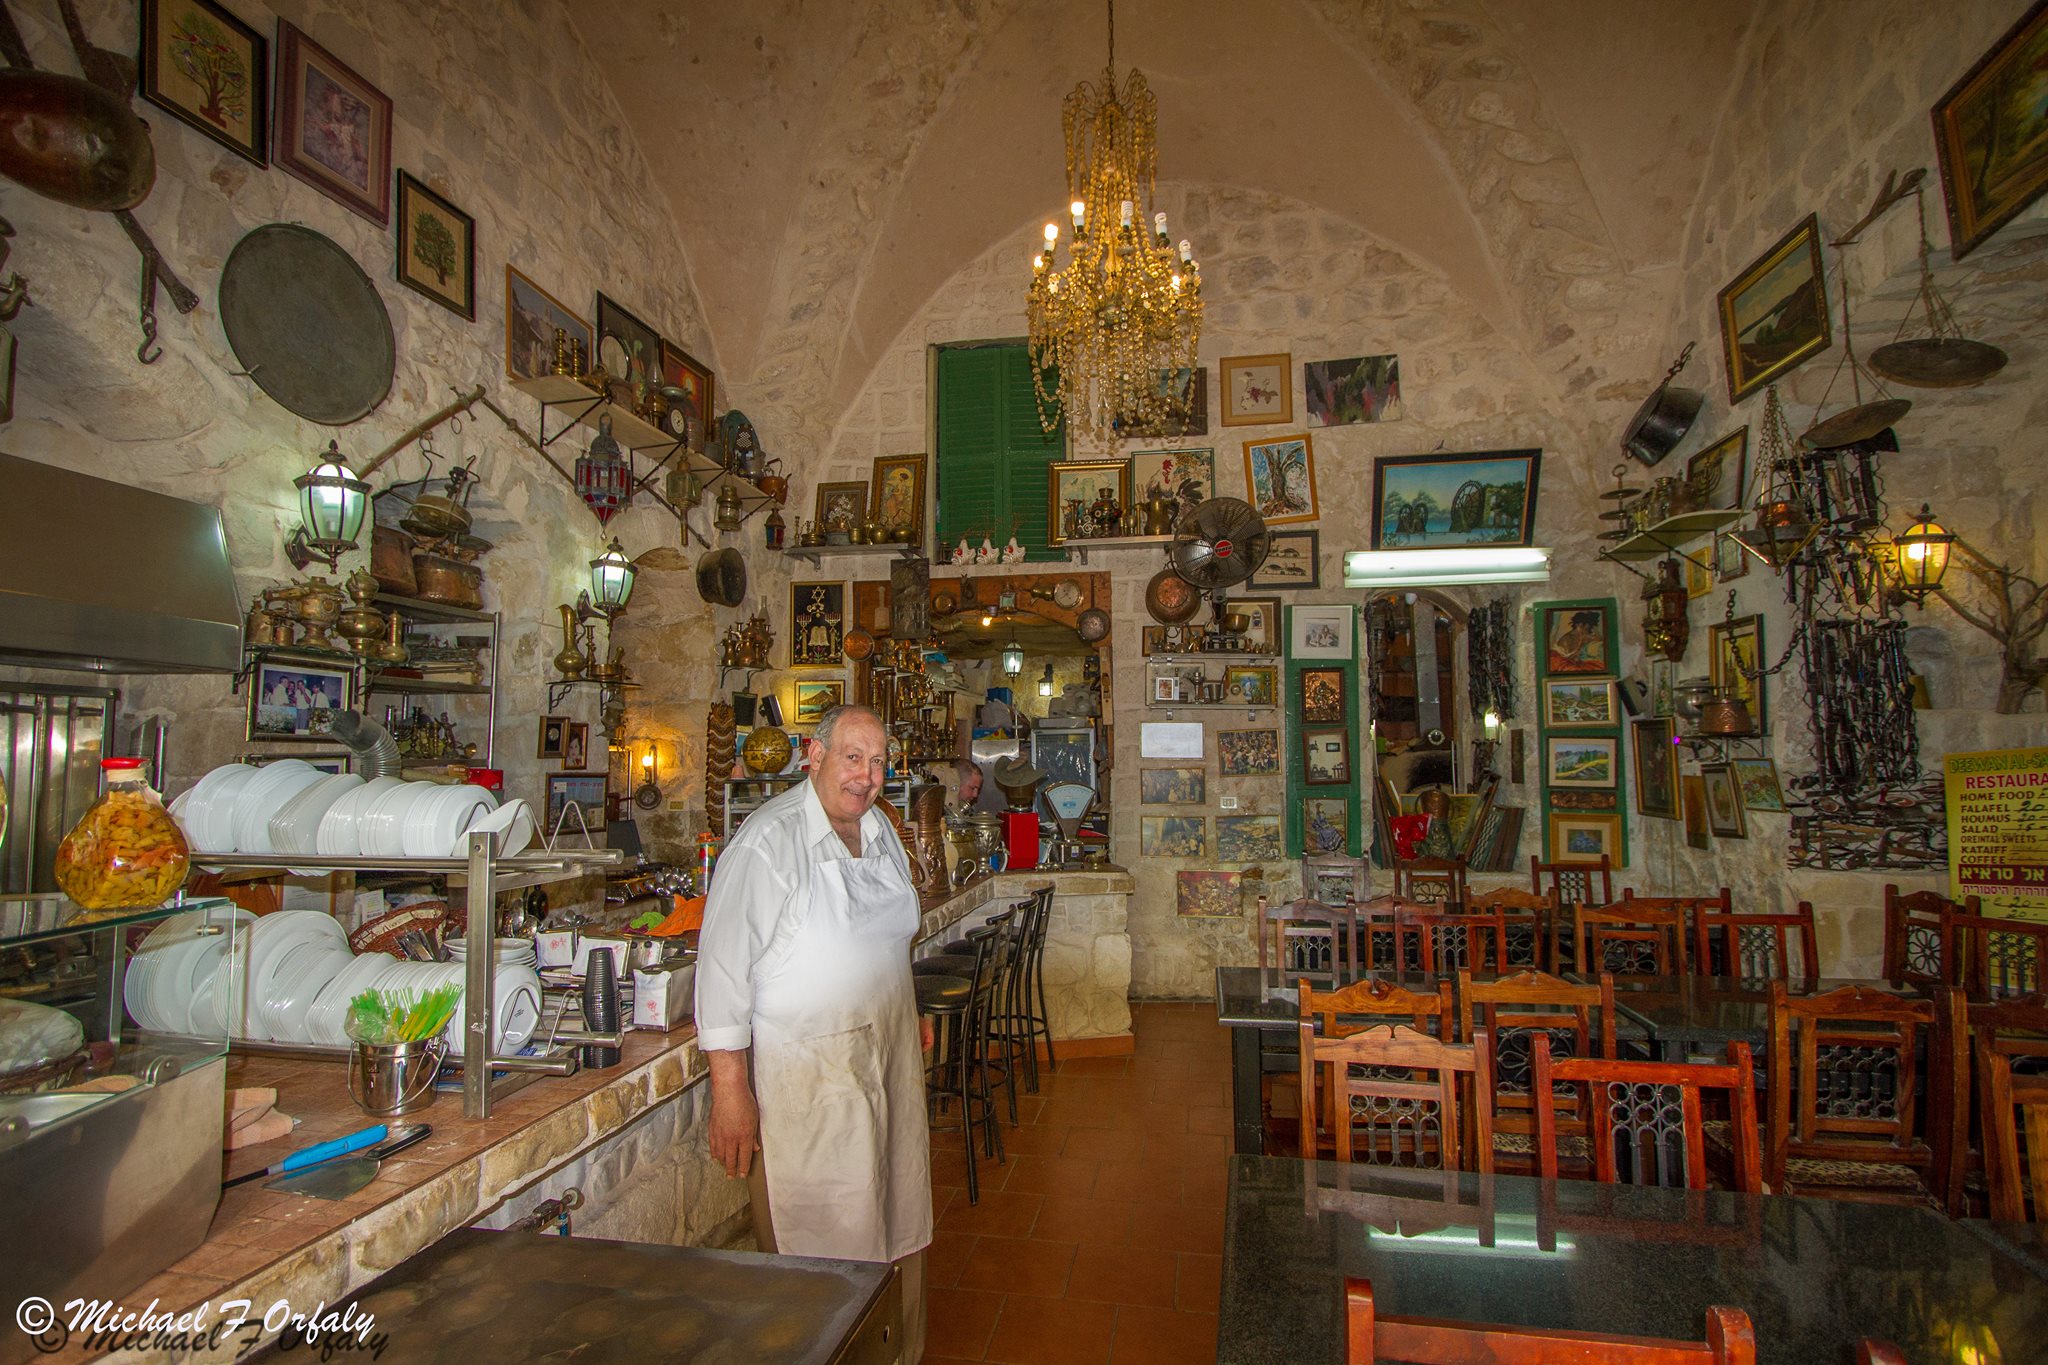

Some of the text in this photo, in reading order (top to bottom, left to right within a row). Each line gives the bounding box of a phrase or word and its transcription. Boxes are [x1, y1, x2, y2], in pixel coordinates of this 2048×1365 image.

[1960, 792, 1994, 802] HOME
[1998, 791, 2035, 800] FOOD
[1960, 803, 2011, 813] FALAFEL
[1961, 814, 2011, 824] HOUMUS
[1960, 825, 1999, 834] SALAD
[2002, 834, 2037, 843] SWEETS
[1960, 846, 2008, 855] KATAIFF
[1960, 855, 2006, 864] COFFEE
